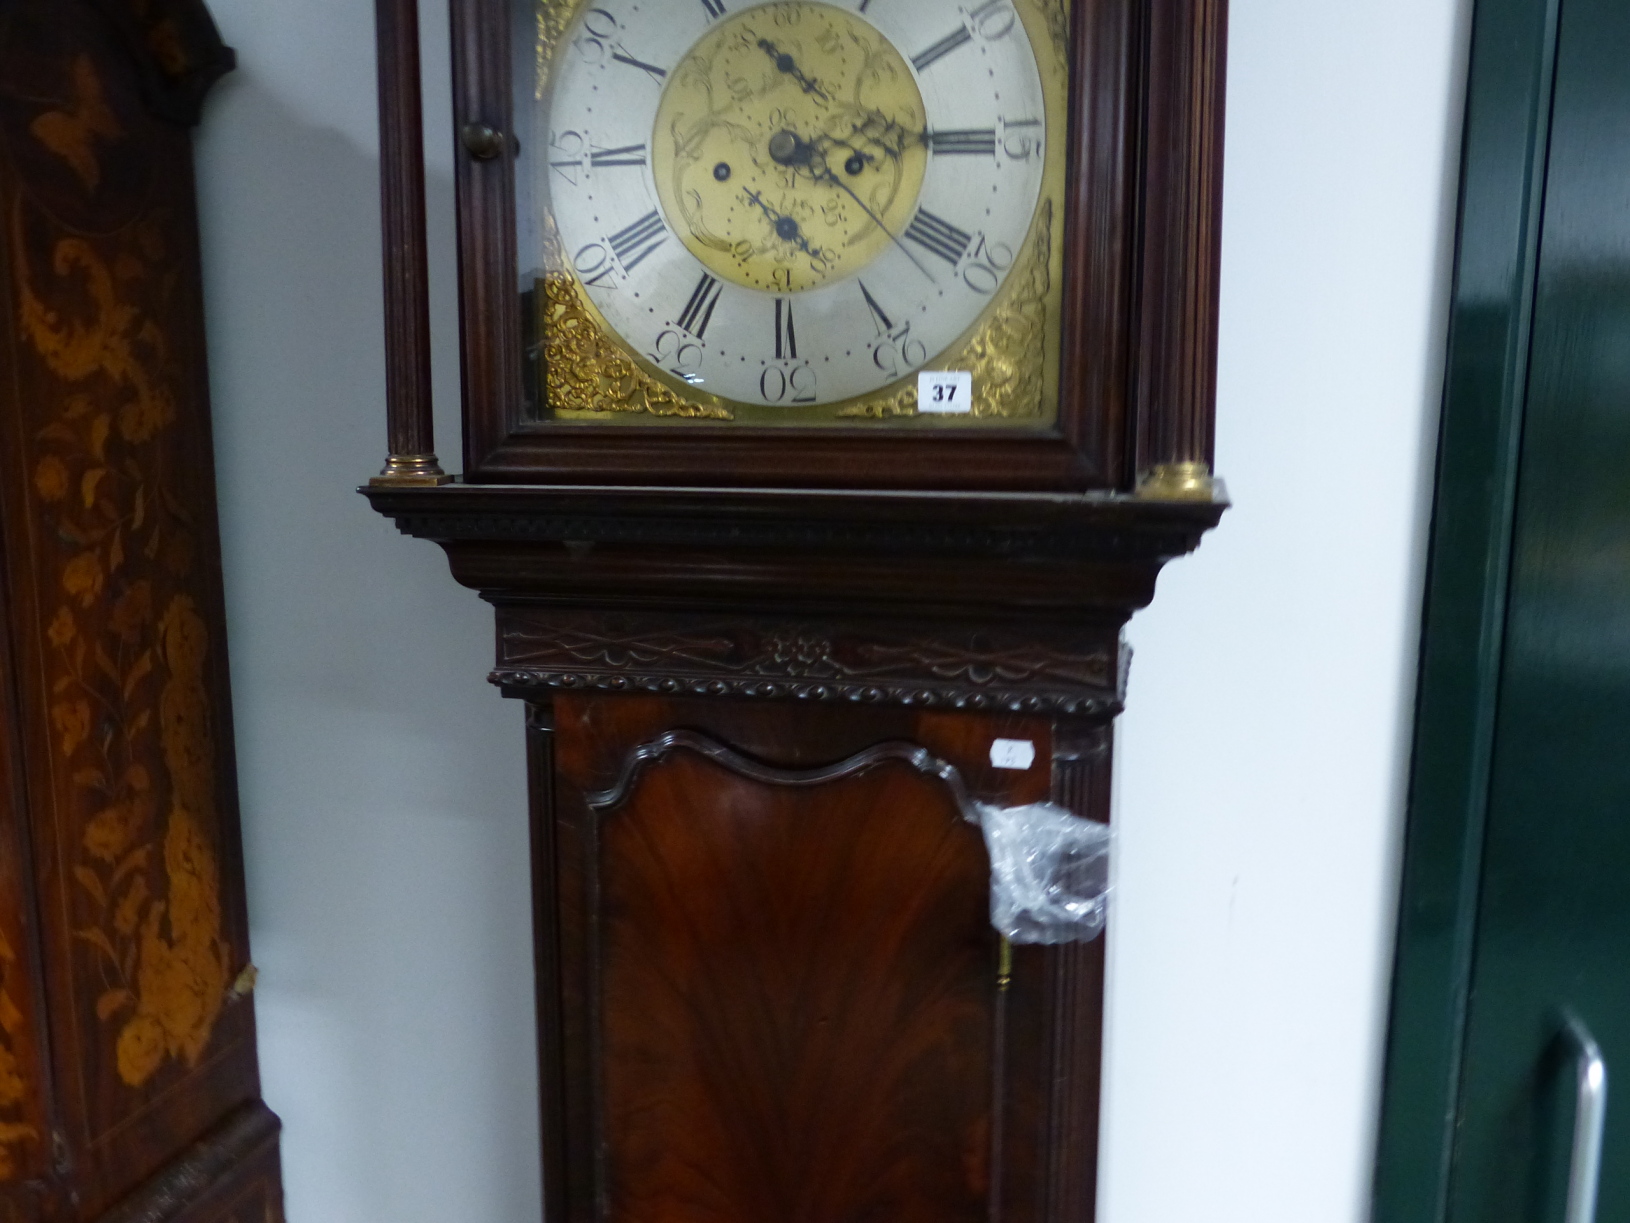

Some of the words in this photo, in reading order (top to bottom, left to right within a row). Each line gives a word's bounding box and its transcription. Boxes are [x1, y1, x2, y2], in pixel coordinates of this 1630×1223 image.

[549, 128, 584, 187] 45
[1002, 114, 1042, 163] 15
[573, 243, 618, 290] 40
[772, 268, 792, 291] 15
[963, 234, 1014, 295] 20
[645, 329, 704, 381] 35
[872, 323, 927, 382] 25
[759, 365, 818, 404] 30
[932, 384, 958, 402] 37
